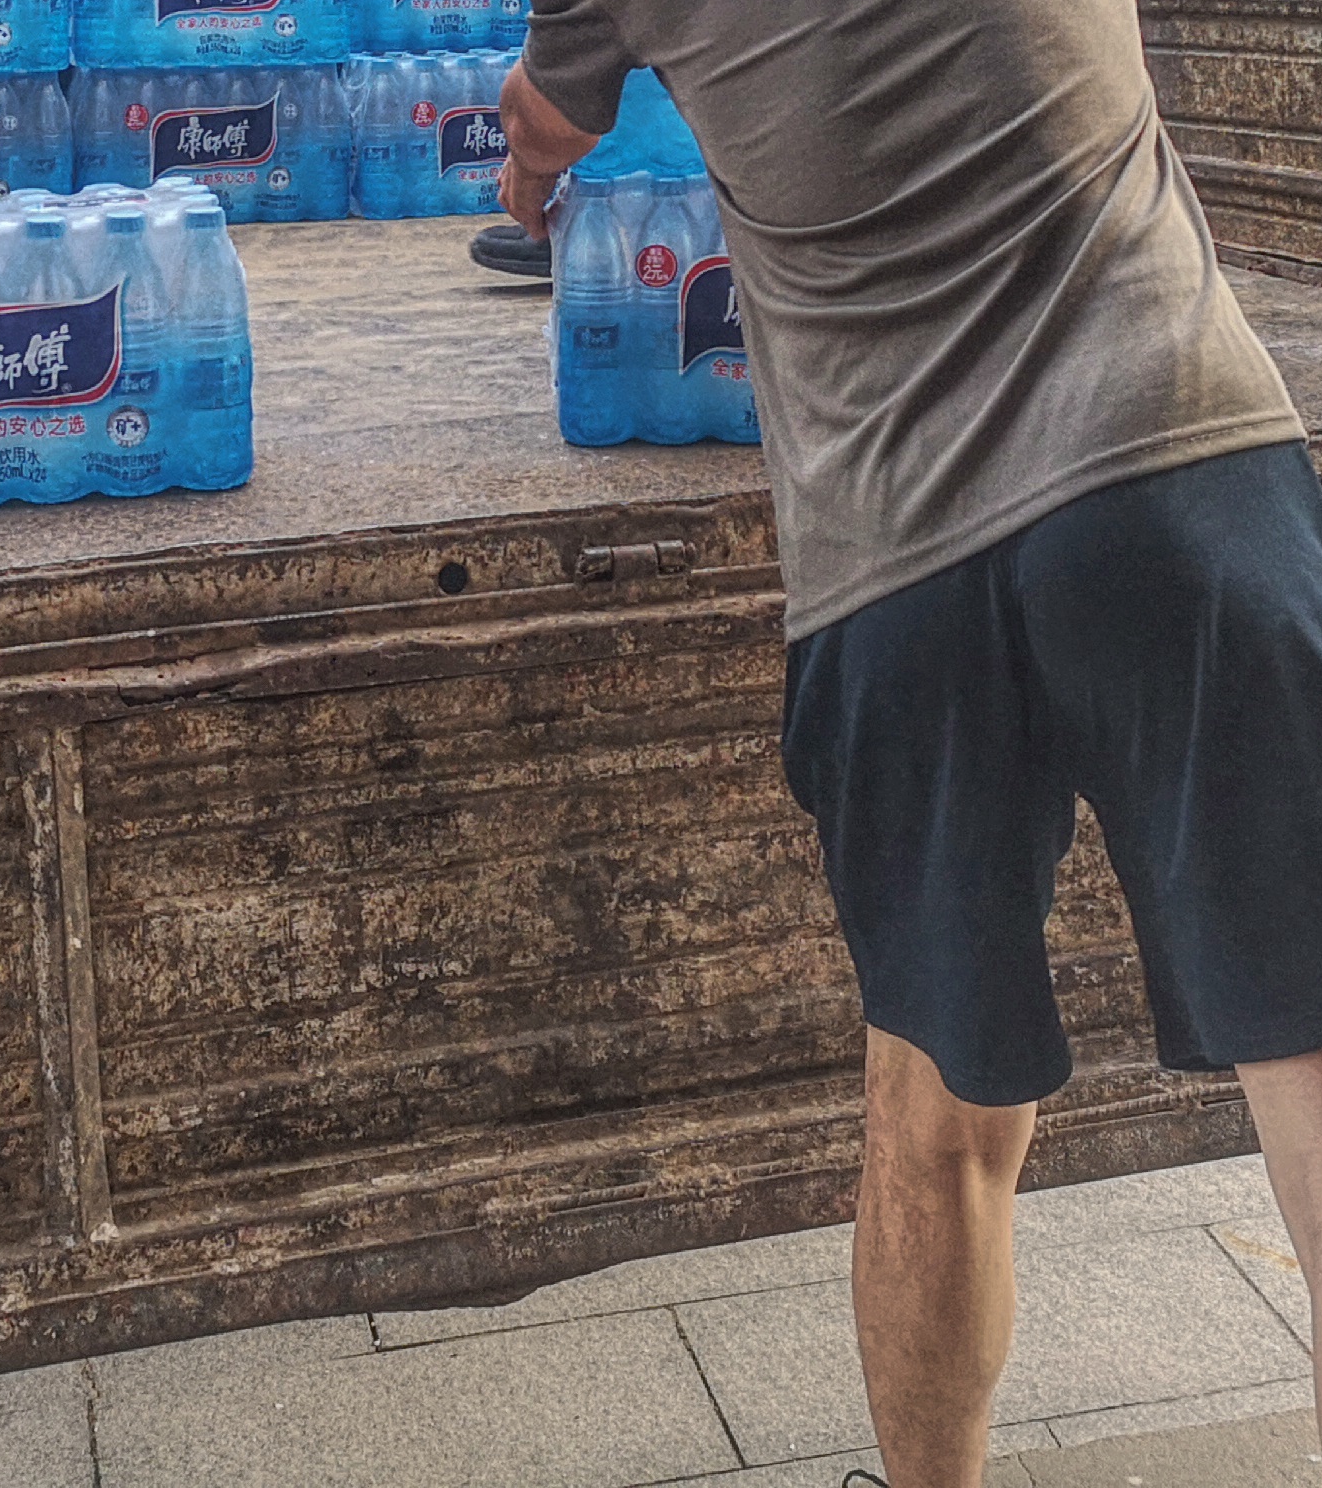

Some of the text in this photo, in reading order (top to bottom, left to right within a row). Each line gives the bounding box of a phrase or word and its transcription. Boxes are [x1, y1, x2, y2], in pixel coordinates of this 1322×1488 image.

[177, 117, 250, 160] 康師傅
[463, 114, 507, 156] 康師
[194, 172, 257, 185] 人的安心之选
[457, 167, 501, 181] 全家人的
